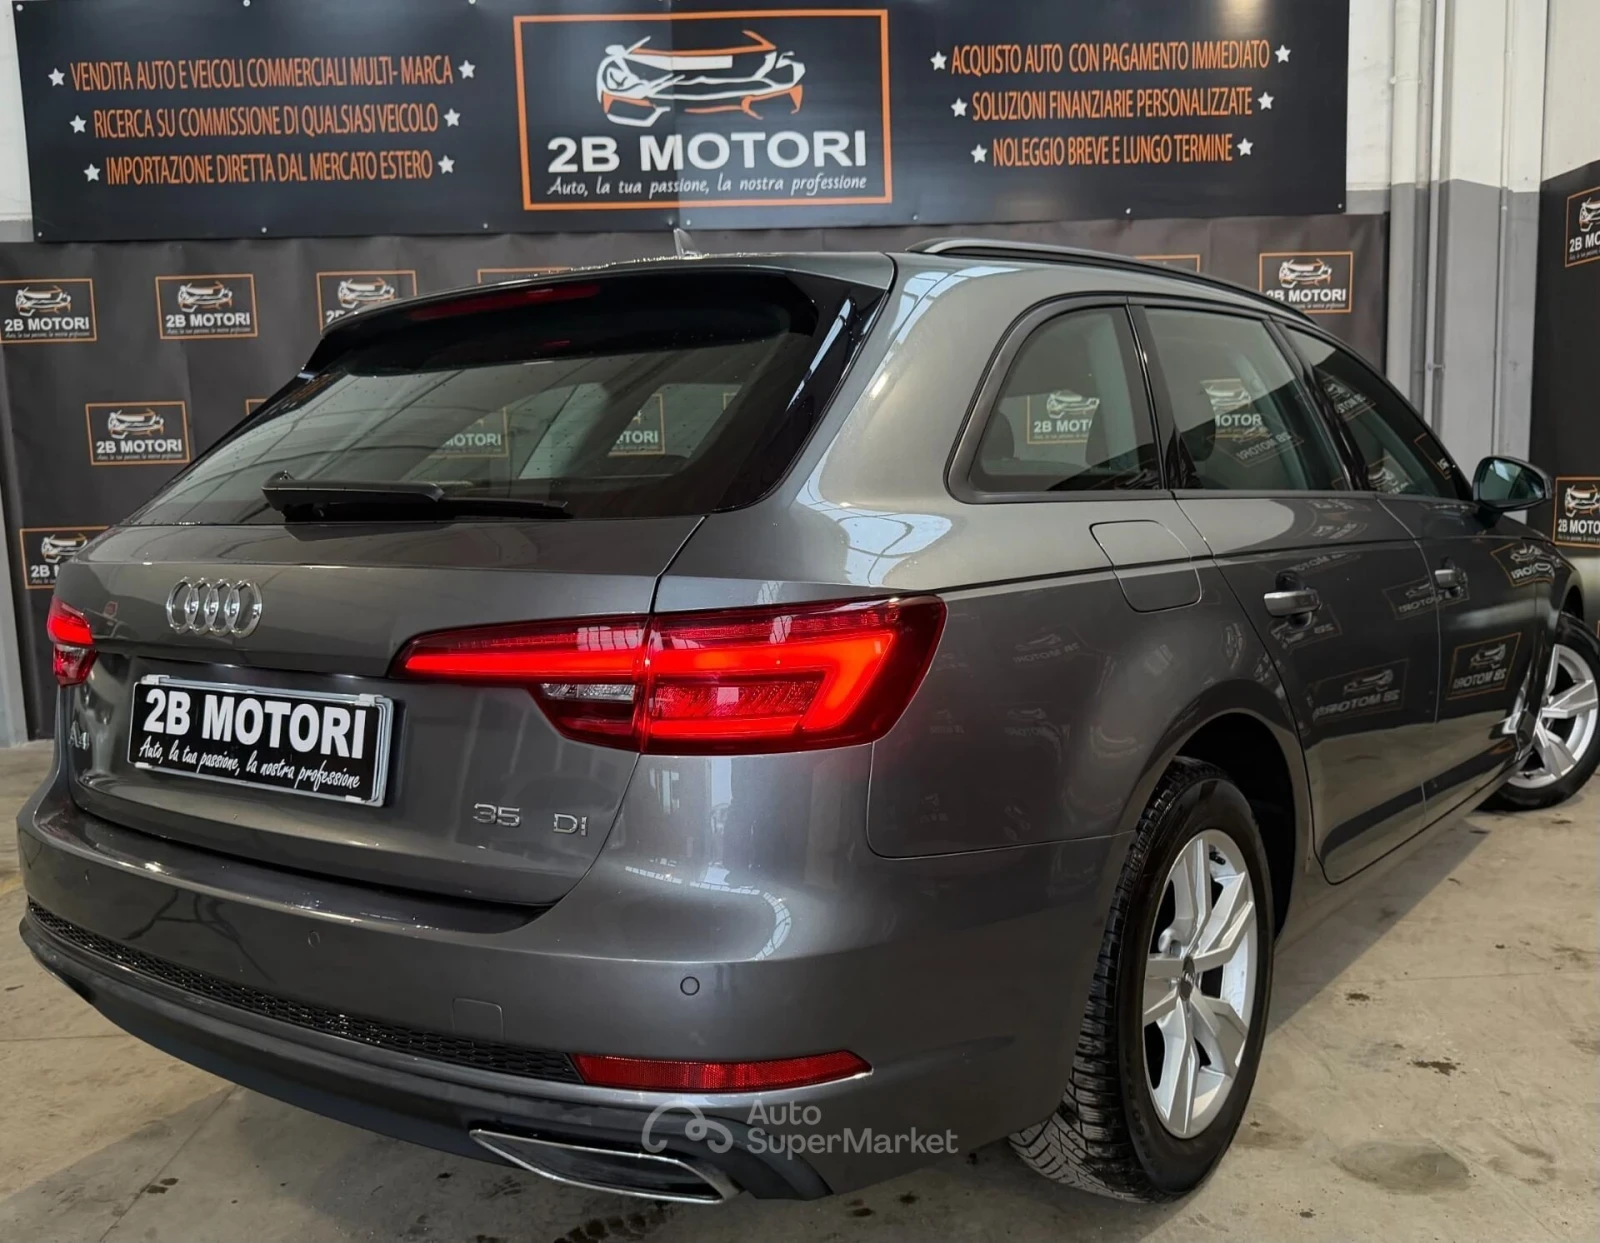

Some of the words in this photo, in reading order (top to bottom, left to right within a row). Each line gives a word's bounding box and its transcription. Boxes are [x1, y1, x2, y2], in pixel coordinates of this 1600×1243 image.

[70, 61, 133, 91] VENDITA
[137, 60, 175, 90] AUTO
[178, 60, 188, 89] E
[188, 59, 244, 89] VEICOLI
[247, 57, 347, 87] COMMERCIALI
[400, 55, 453, 85] MARCA
[951, 44, 1021, 77] ACQUISTO
[1024, 43, 1063, 73] AUTO
[1069, 43, 1099, 72] CON
[1102, 41, 1188, 72] PAGAMENTO
[1192, 39, 1270, 69] IMMEDIATO
[93, 109, 154, 138] RICERCA
[156, 108, 175, 137] SU
[179, 106, 281, 137] COMMISSIONE
[283, 105, 299, 135] DI
[301, 104, 376, 138] QUALSIASI
[376, 103, 438, 133] VEICOLO
[972, 91, 1046, 121] SOLUZIONI
[1049, 89, 1134, 119] FINANZIARIE
[1137, 87, 1253, 117] PERSONALIZZATE
[547, 136, 620, 173] 2B
[640, 130, 866, 172] MOTORI
[993, 136, 1065, 167] NOLEGGIO
[1068, 136, 1109, 165] BREVE
[1112, 136, 1120, 164] E
[1123, 134, 1172, 164] LUNGO
[1173, 133, 1233, 163] TERMINE
[106, 155, 214, 185] IMPORTAZIONE
[216, 153, 276, 183] DIRETTA
[277, 153, 307, 182] DAL
[309, 151, 377, 181] MERCATO
[380, 150, 433, 180] ESTERO
[547, 176, 588, 197] Auto,
[596, 176, 610, 194] la
[618, 180, 642, 194] tua
[649, 177, 709, 199] passione,
[717, 172, 731, 191] la
[739, 176, 783, 191] nostra
[790, 172, 867, 196] professione
[1569, 236, 1582, 253] 2B
[1288, 288, 1346, 302] MOTORI
[4, 319, 24, 331] 2B
[28, 317, 89, 331] MOTORI
[166, 314, 186, 327] 2B
[190, 312, 250, 327] MOTORI
[1034, 420, 1052, 433] 2B
[1056, 419, 1092, 432] MOT
[96, 440, 116, 453] 2B
[120, 438, 182, 453] MOTORI
[1558, 518, 1568, 532] 2B
[30, 564, 50, 577] 2B
[143, 688, 191, 736] 2B
[202, 694, 366, 759] MOTORI
[138, 735, 163, 764] Auto,
[168, 739, 179, 762] la
[182, 745, 198, 765] tua
[196, 751, 240, 776] passione,
[246, 750, 257, 773] la
[260, 758, 295, 779] nostra
[294, 760, 360, 792] professione
[473, 803, 520, 827] 35
[553, 813, 587, 836] DI
